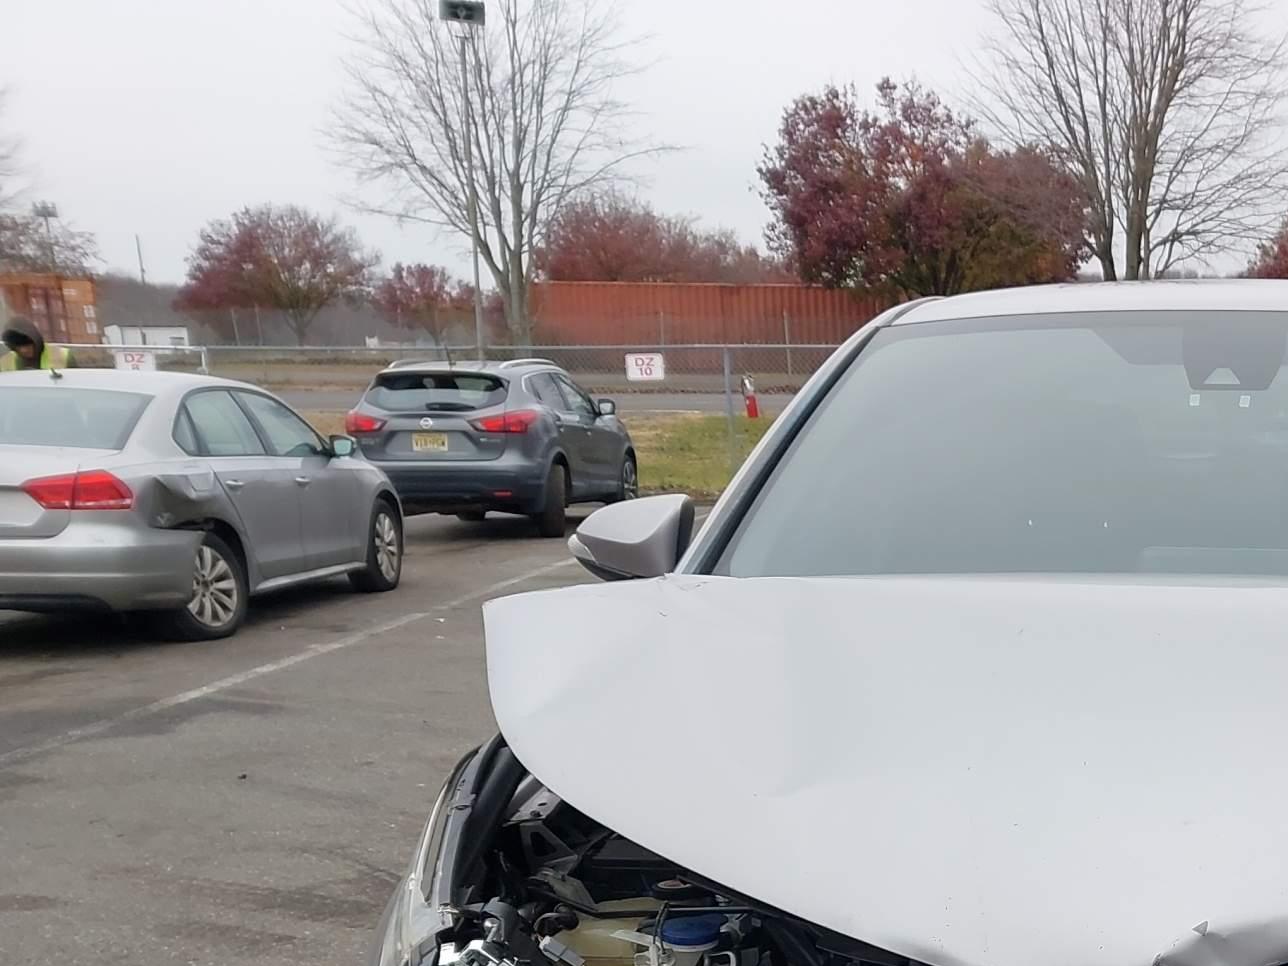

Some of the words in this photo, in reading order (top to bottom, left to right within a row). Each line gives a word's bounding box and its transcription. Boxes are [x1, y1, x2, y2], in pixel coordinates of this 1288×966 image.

[124, 353, 145, 363] DZ
[634, 357, 655, 367] DZ
[639, 367, 652, 376] 10
